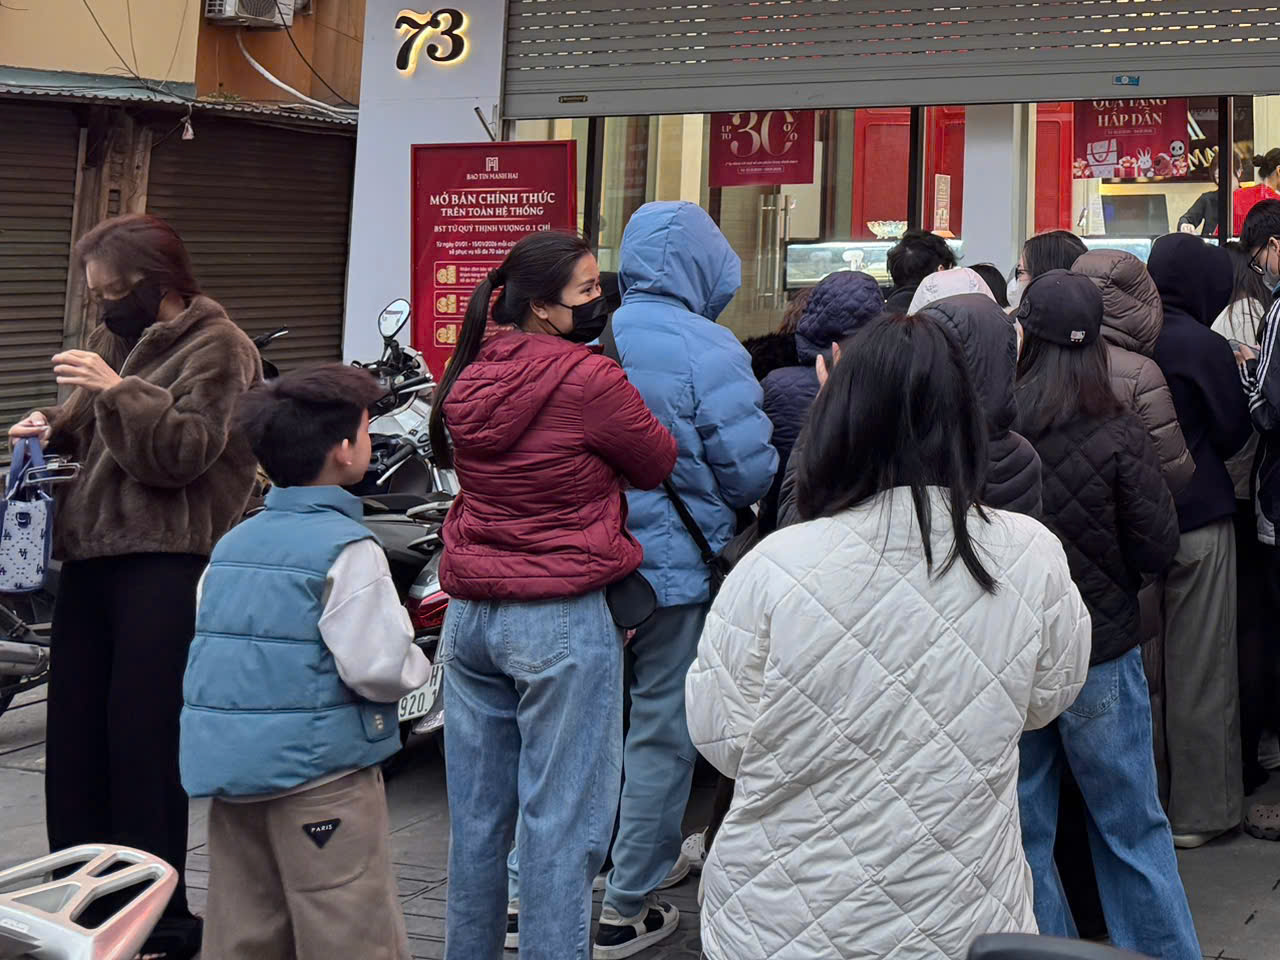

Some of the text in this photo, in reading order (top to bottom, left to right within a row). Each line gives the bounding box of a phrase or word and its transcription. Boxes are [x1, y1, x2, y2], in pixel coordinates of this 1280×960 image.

[395, 8, 466, 71] 73
[1098, 106, 1163, 127] HẤP DẪN
[430, 190, 555, 205] MỞ BÁN CHÍNH THỨC
[441, 204, 544, 217] TRÊN TOÀN HỆ THỐNG
[475, 224, 497, 234] THỊNH
[311, 824, 333, 832] PARIS
